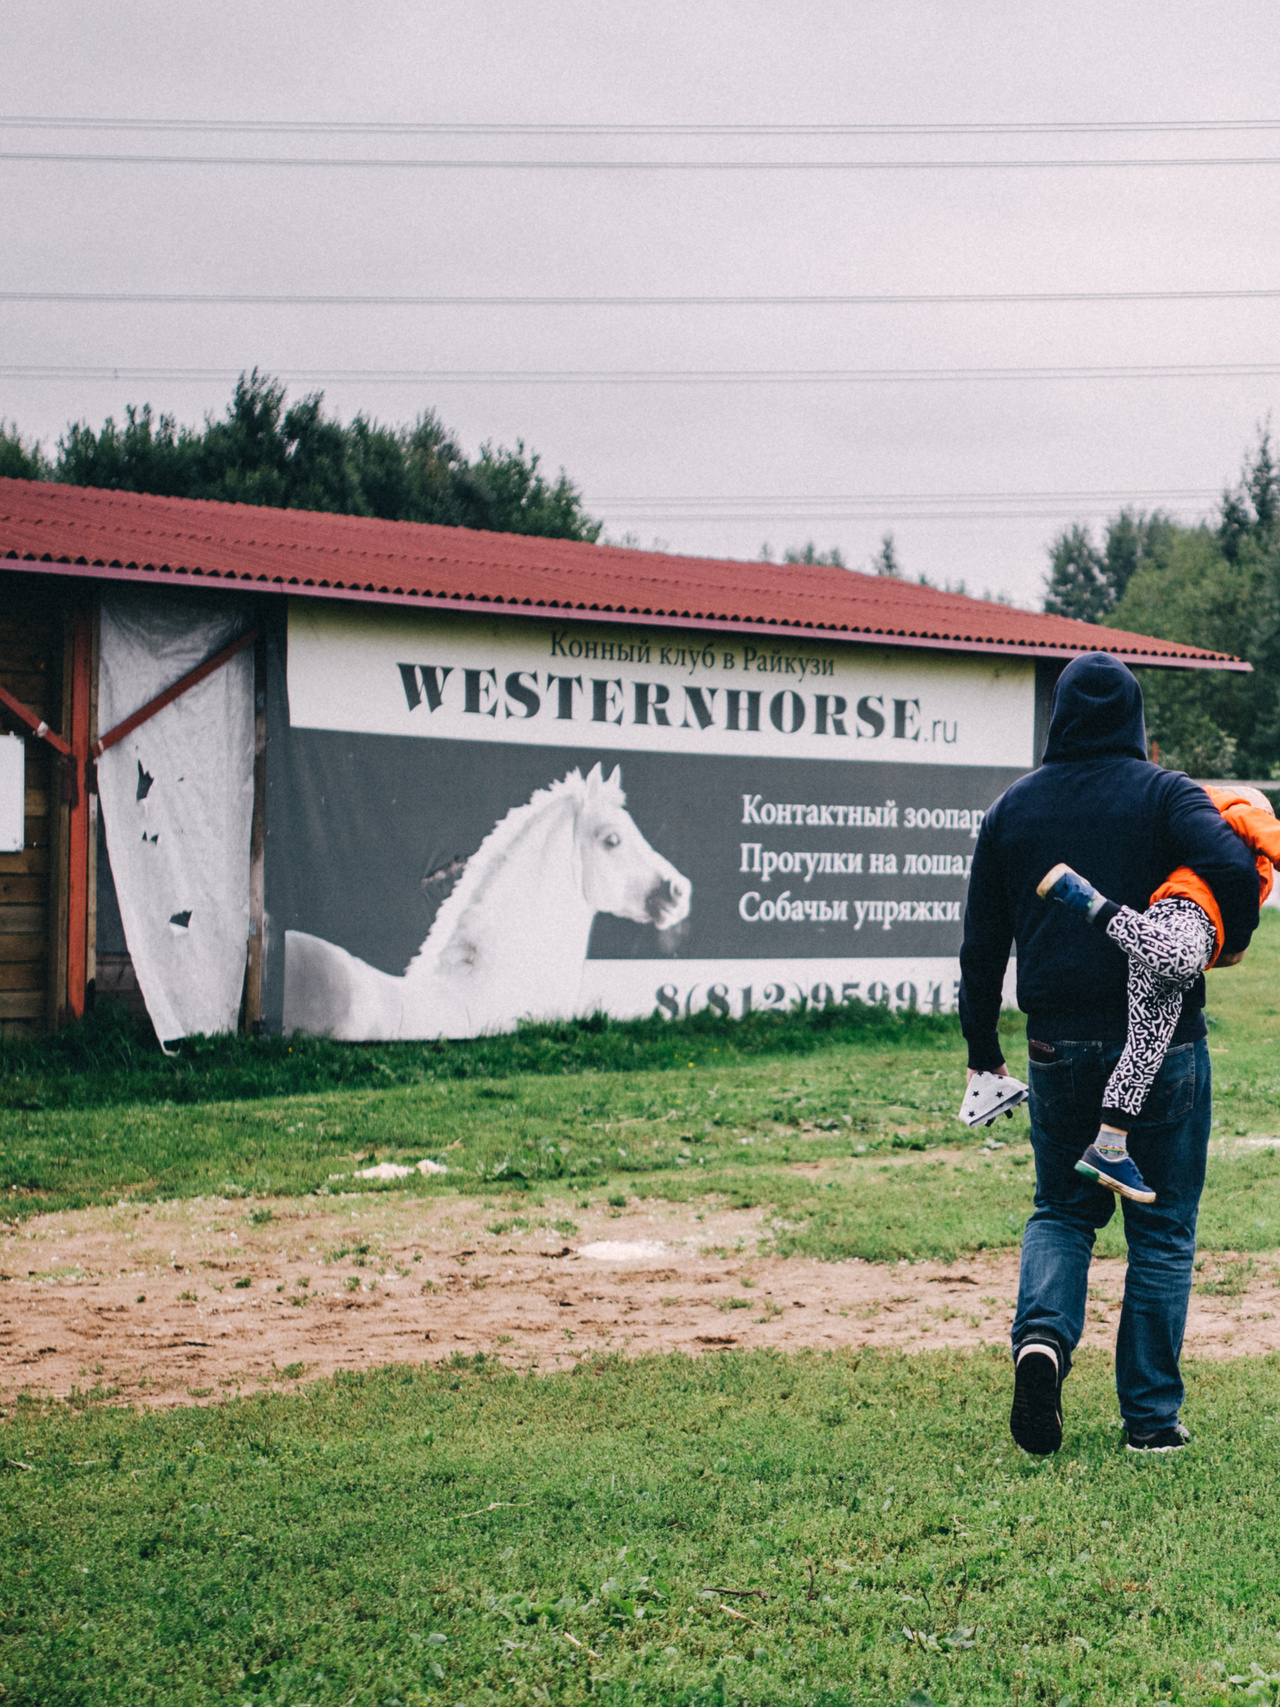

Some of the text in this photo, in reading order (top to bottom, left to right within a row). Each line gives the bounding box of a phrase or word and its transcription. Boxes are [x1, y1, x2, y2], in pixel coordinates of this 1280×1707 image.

[549, 628, 835, 683] Конный клуб в Райкузи
[741, 793, 899, 828] Контактный
[739, 842, 864, 883] Прогулки
[870, 853, 897, 875] на
[738, 889, 961, 931] Собачьи упряжки
